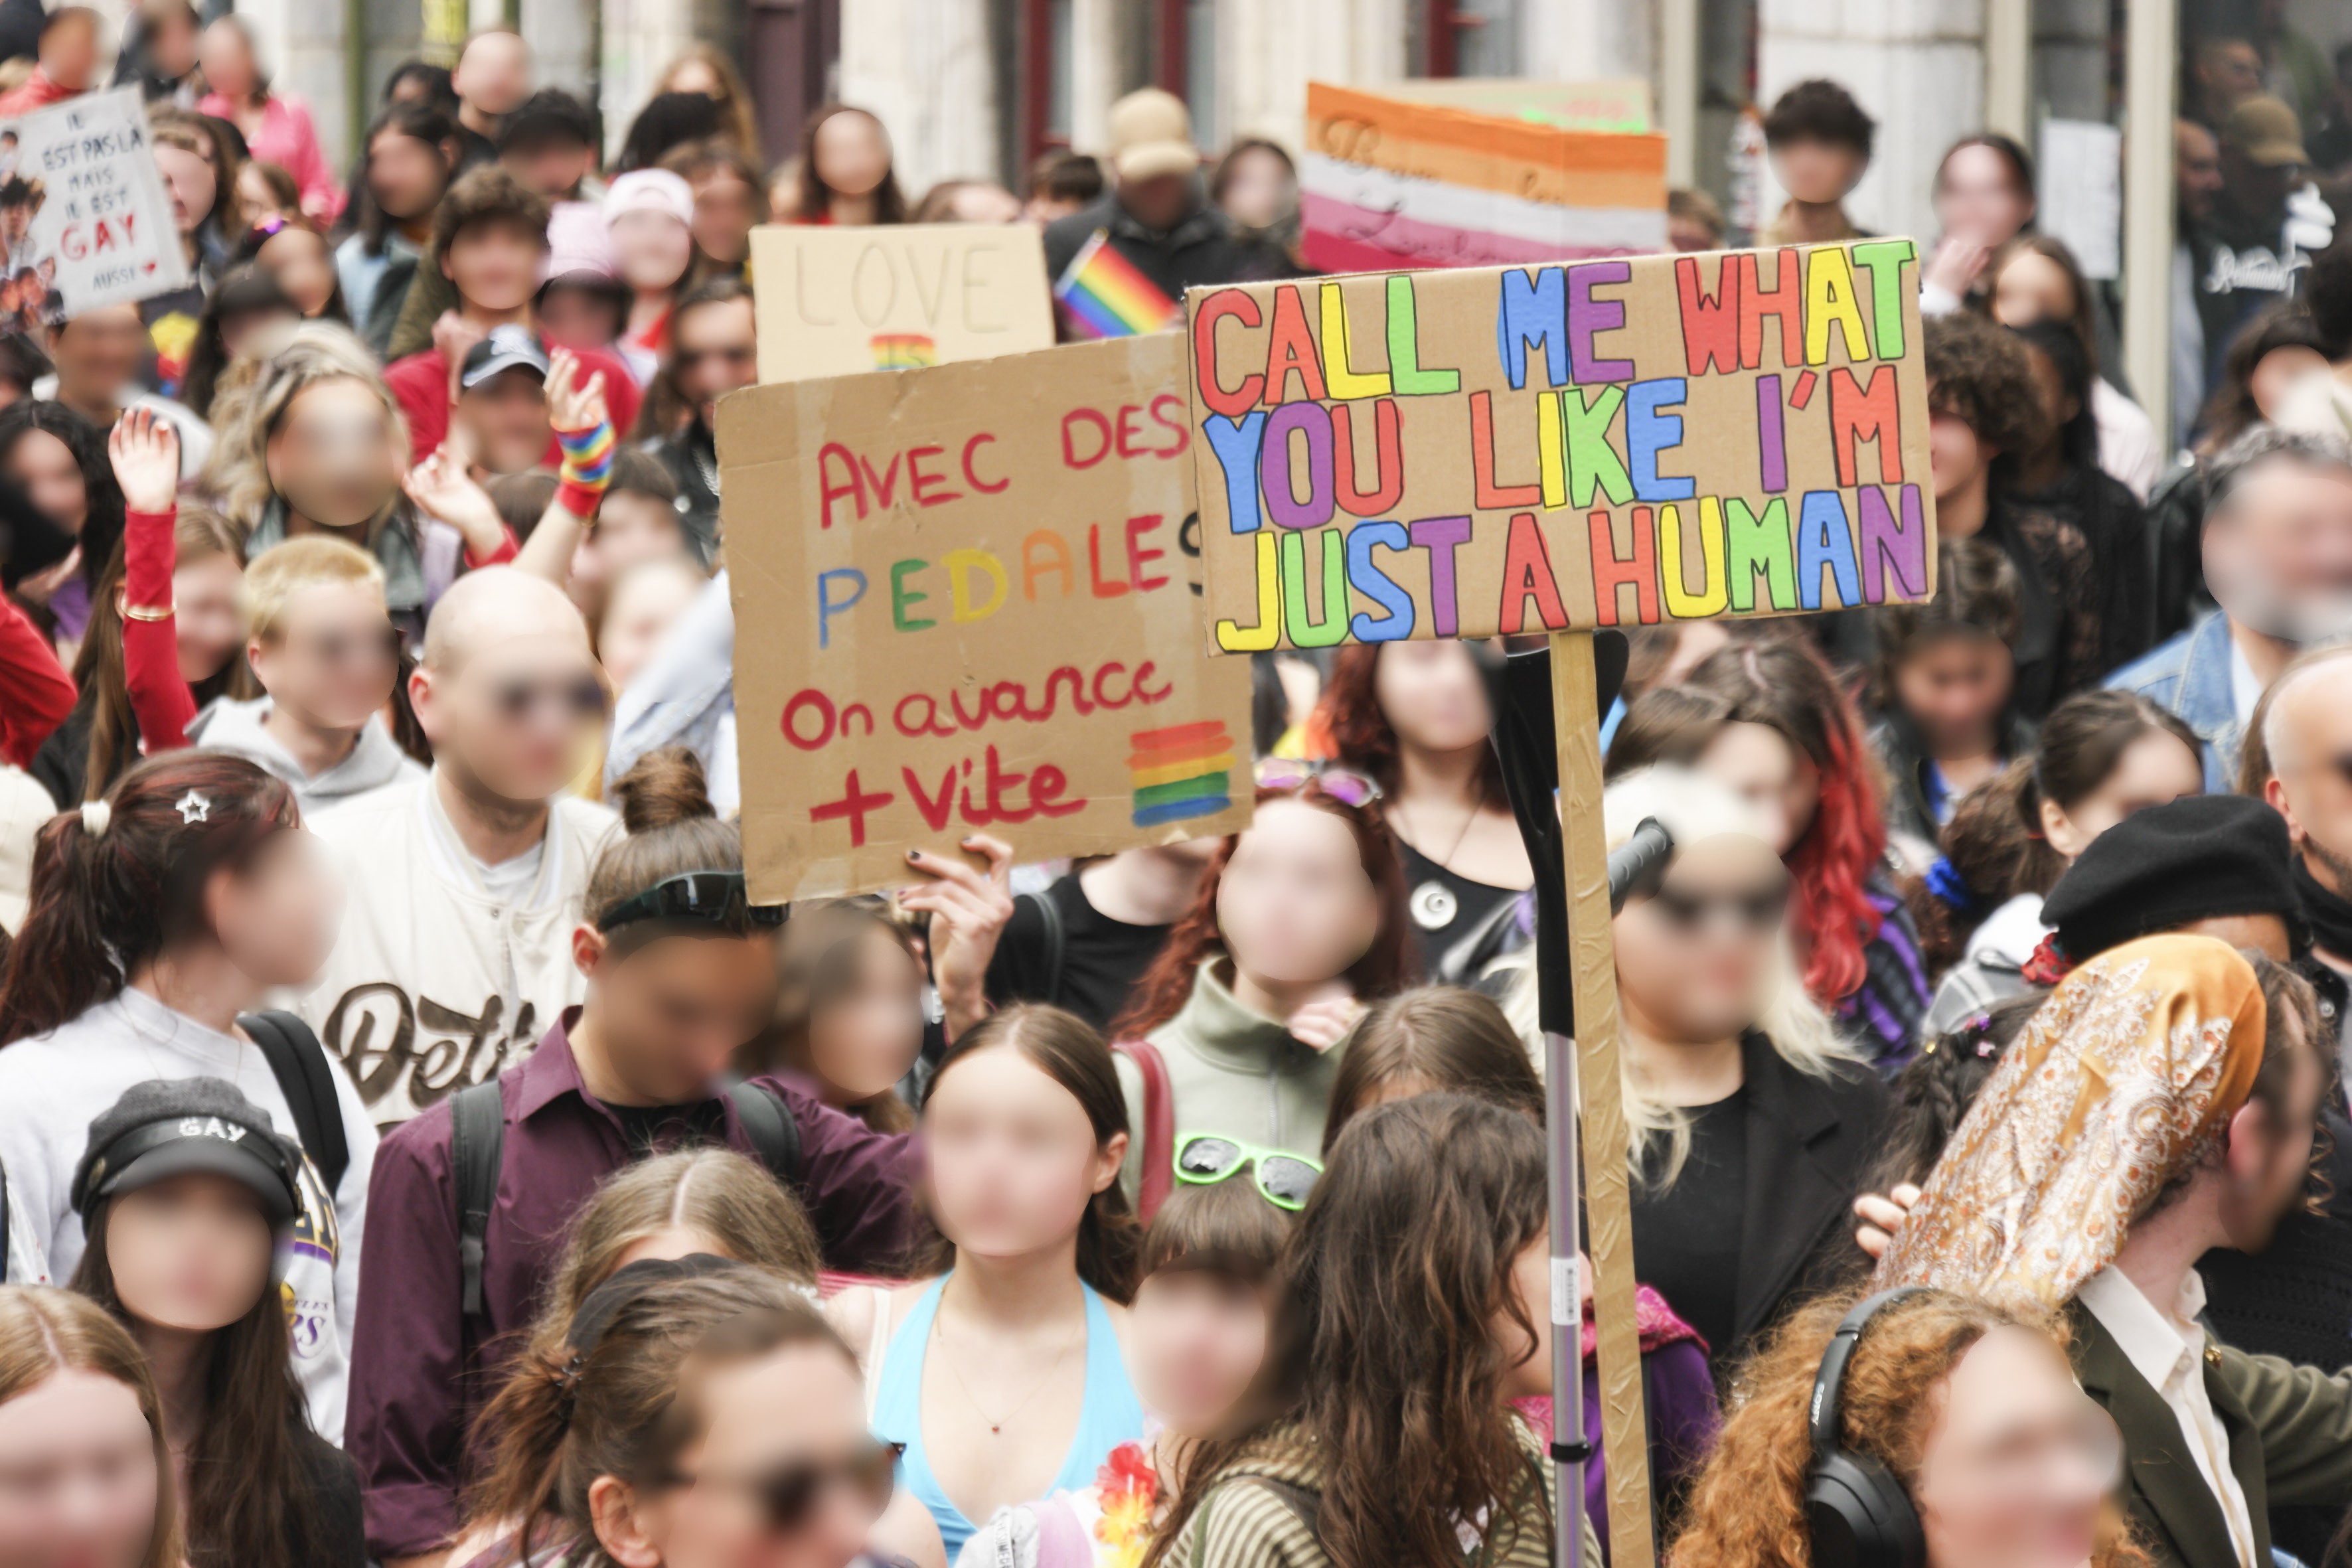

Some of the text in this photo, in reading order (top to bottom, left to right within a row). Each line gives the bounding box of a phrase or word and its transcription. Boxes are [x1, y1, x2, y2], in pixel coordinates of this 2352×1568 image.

[41, 143, 76, 171] EST
[82, 135, 116, 162] PAS
[67, 113, 84, 130] IL
[66, 187, 128, 220] IL EST
[68, 166, 114, 192] MAIS
[60, 212, 135, 262] GAY
[797, 241, 1009, 333] LOVE
[1194, 240, 1918, 416] CALL ME WHAT
[817, 394, 1191, 530] AVEC DES
[1202, 364, 1905, 533] YOU LIKE I'M
[1215, 484, 1928, 652] JUST A HUMAN
[780, 661, 1173, 751] On avance
[1811, 1381, 1825, 1427] SONY
